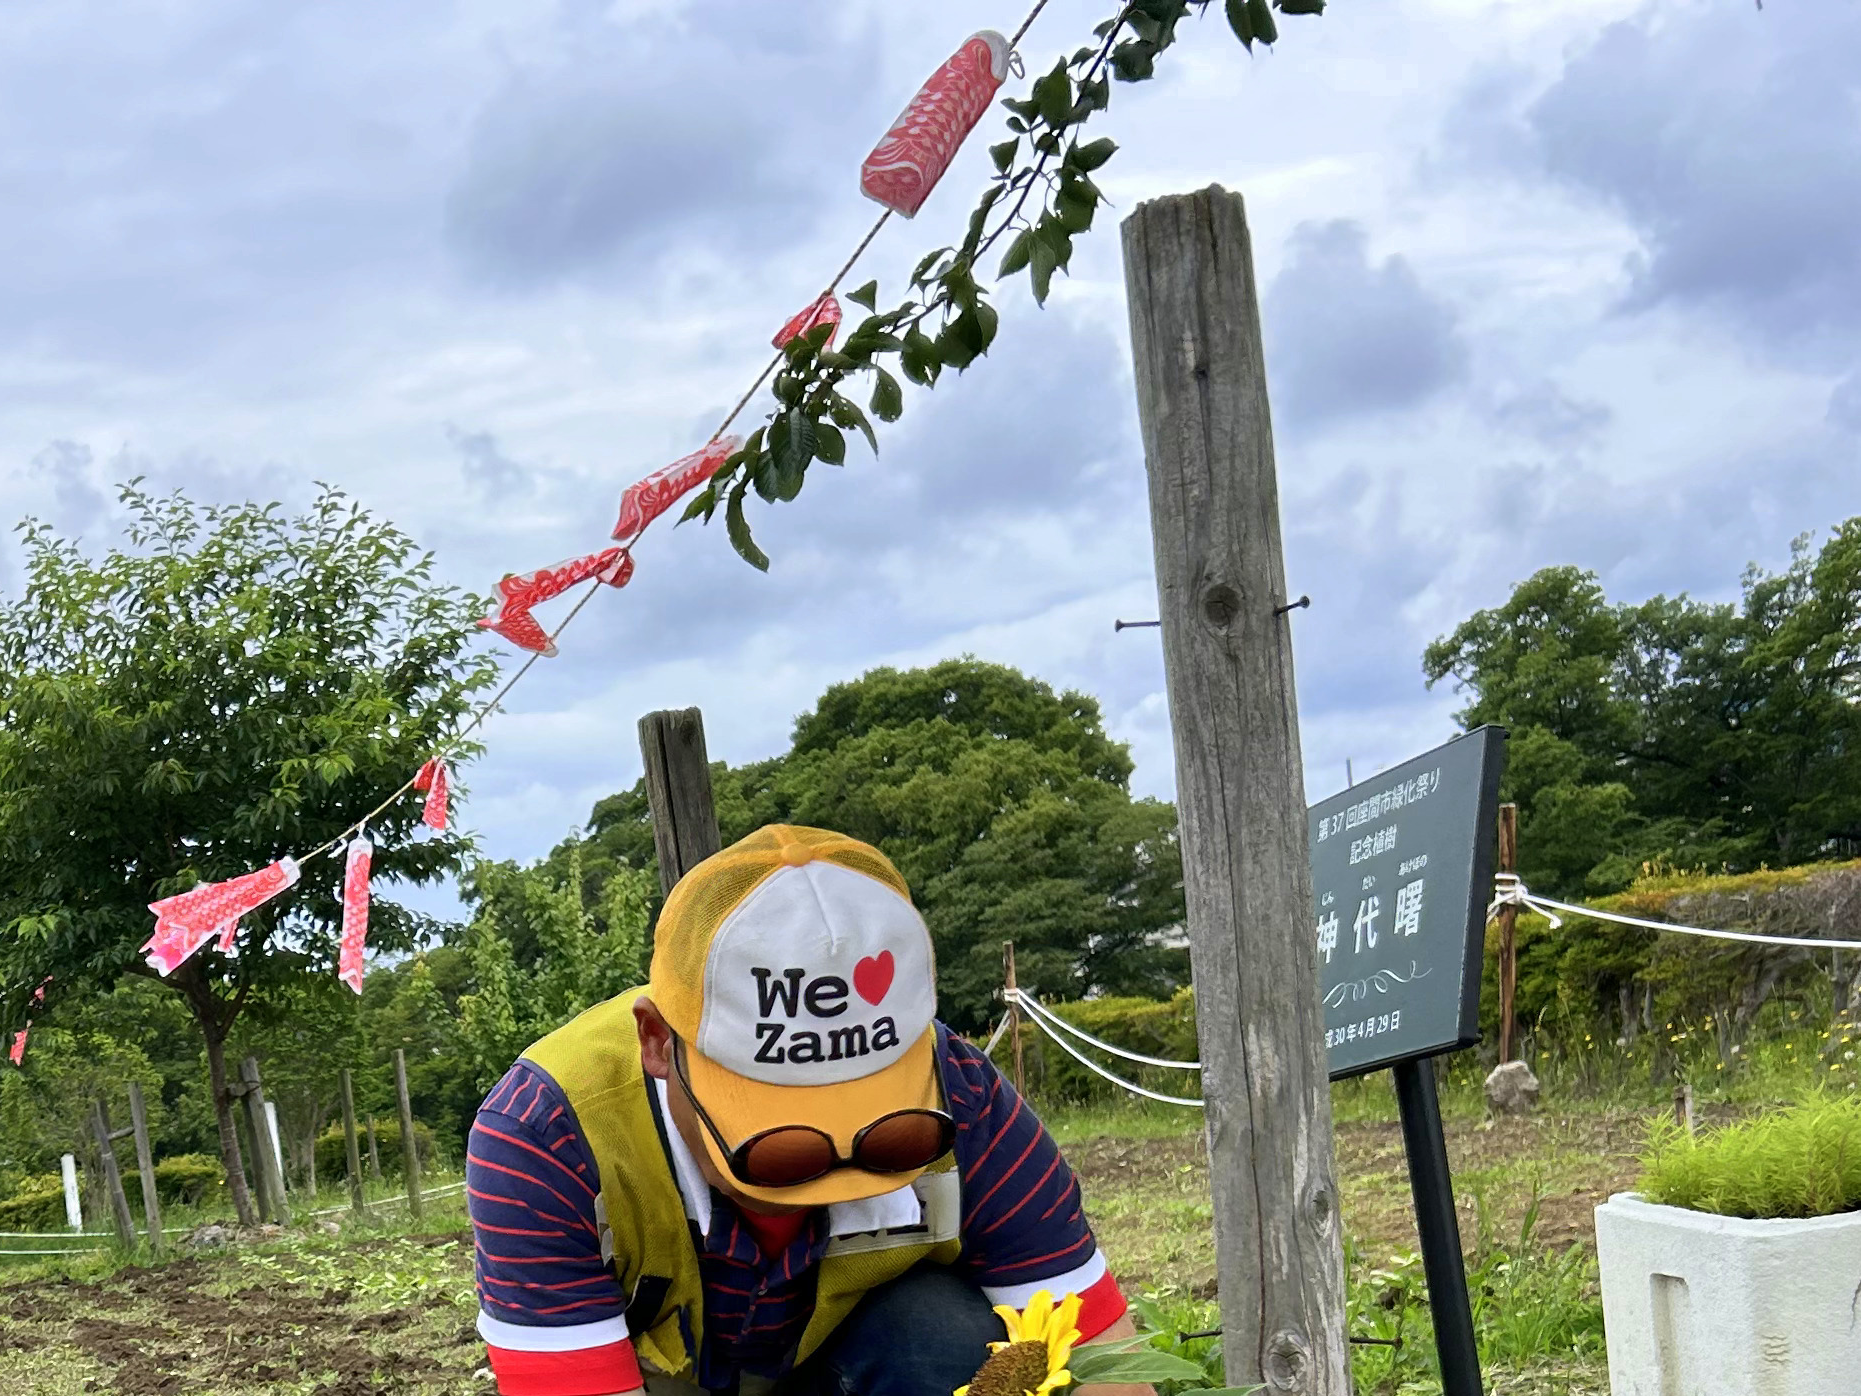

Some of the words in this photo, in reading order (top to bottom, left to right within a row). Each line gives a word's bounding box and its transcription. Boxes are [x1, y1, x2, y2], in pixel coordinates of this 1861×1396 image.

[1349, 823, 1398, 865] 記念植樹
[750, 967, 850, 1019] We
[753, 1015, 900, 1064] Zama
